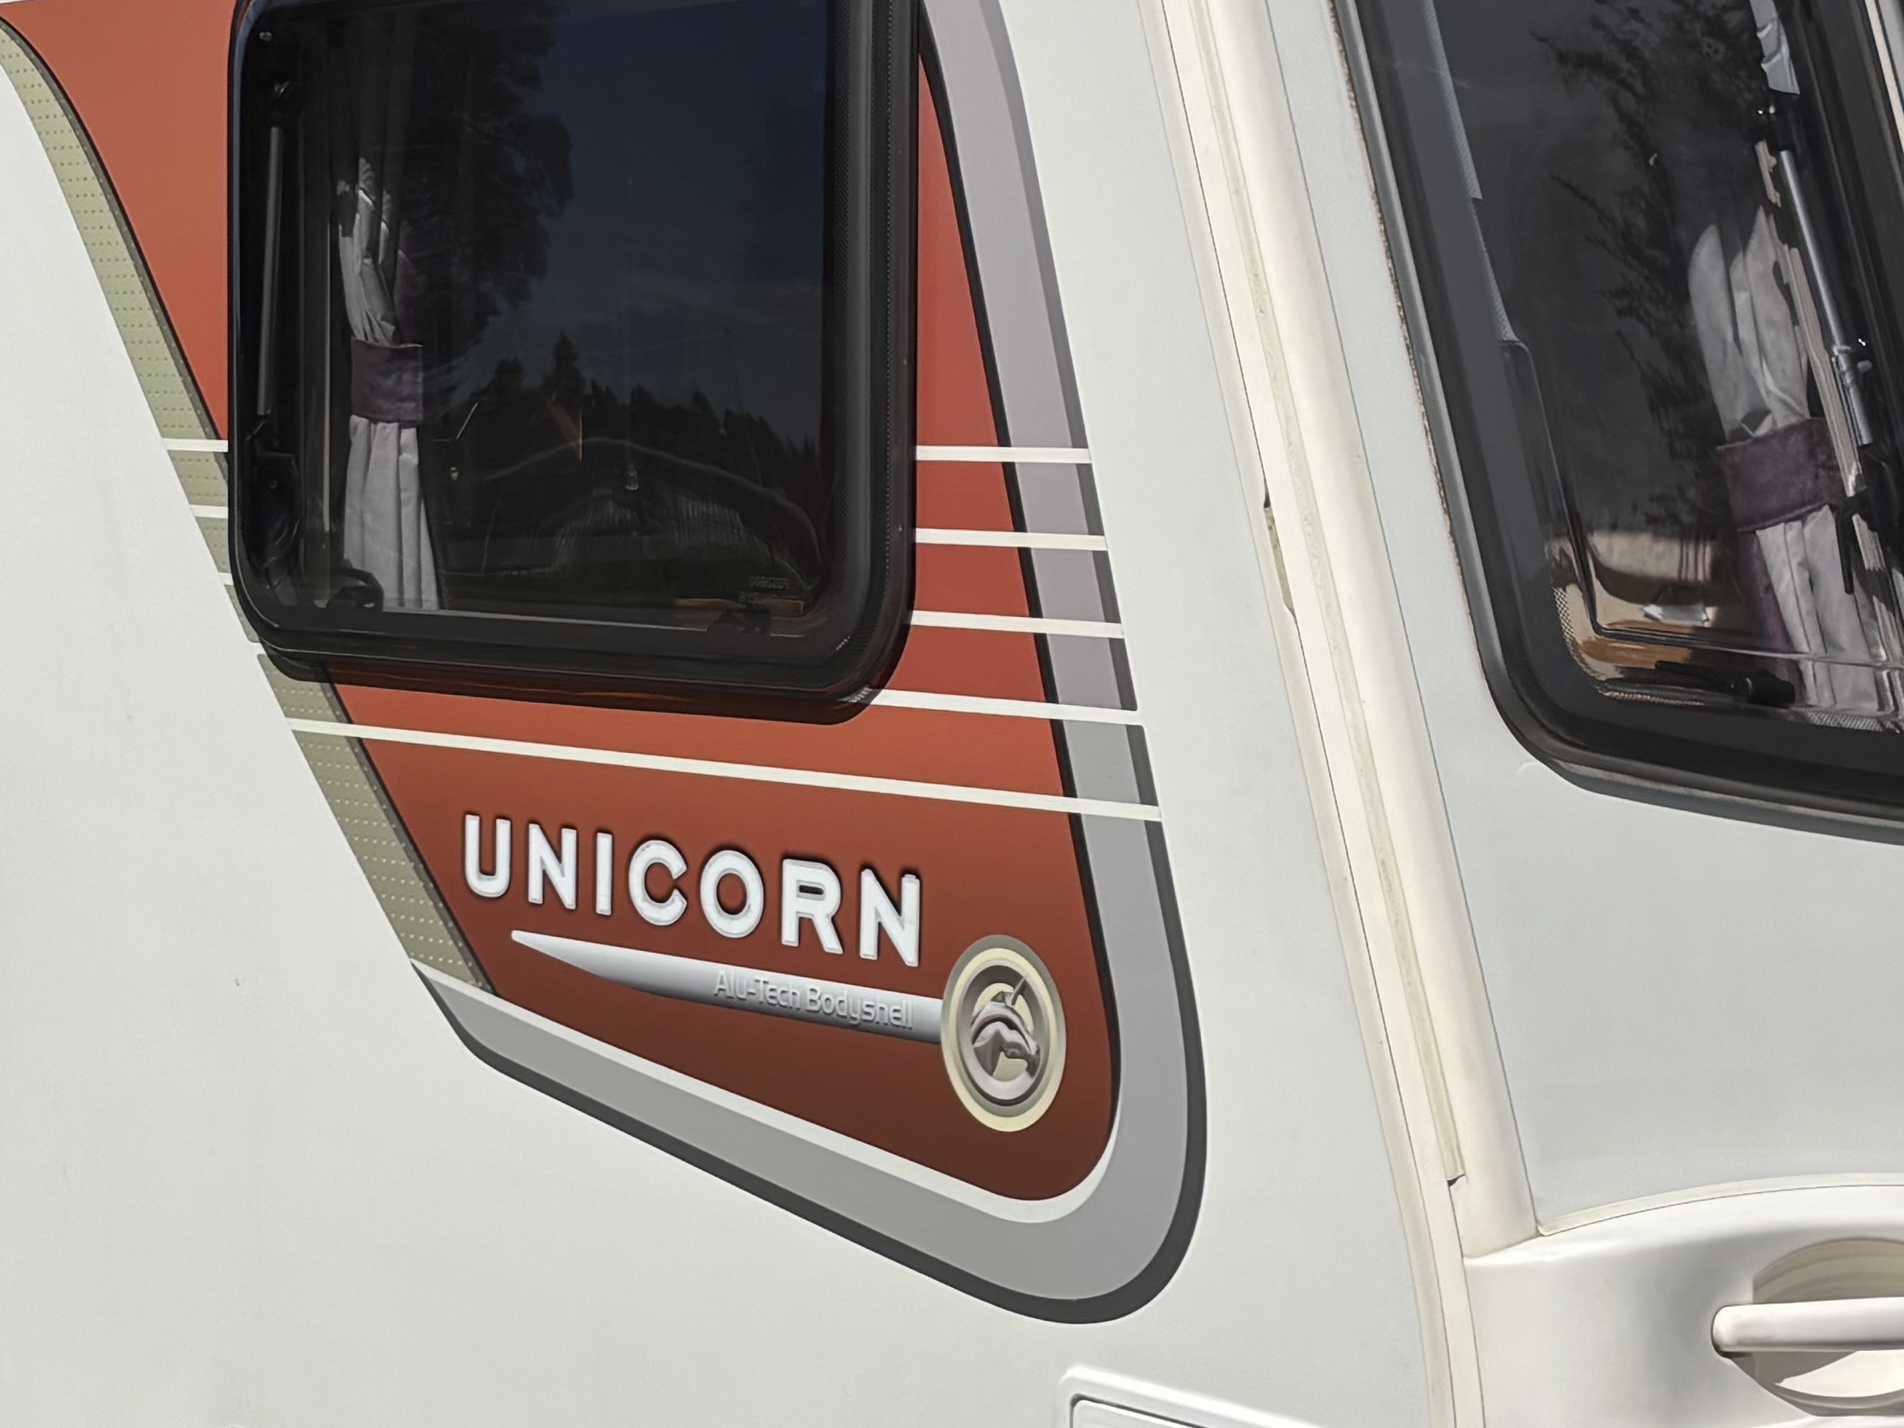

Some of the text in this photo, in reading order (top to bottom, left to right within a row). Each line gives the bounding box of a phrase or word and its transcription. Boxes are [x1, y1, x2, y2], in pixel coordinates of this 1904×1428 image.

[463, 813, 922, 968] UNICORN
[713, 970, 914, 1030] Alu-Tech Bodyshell
